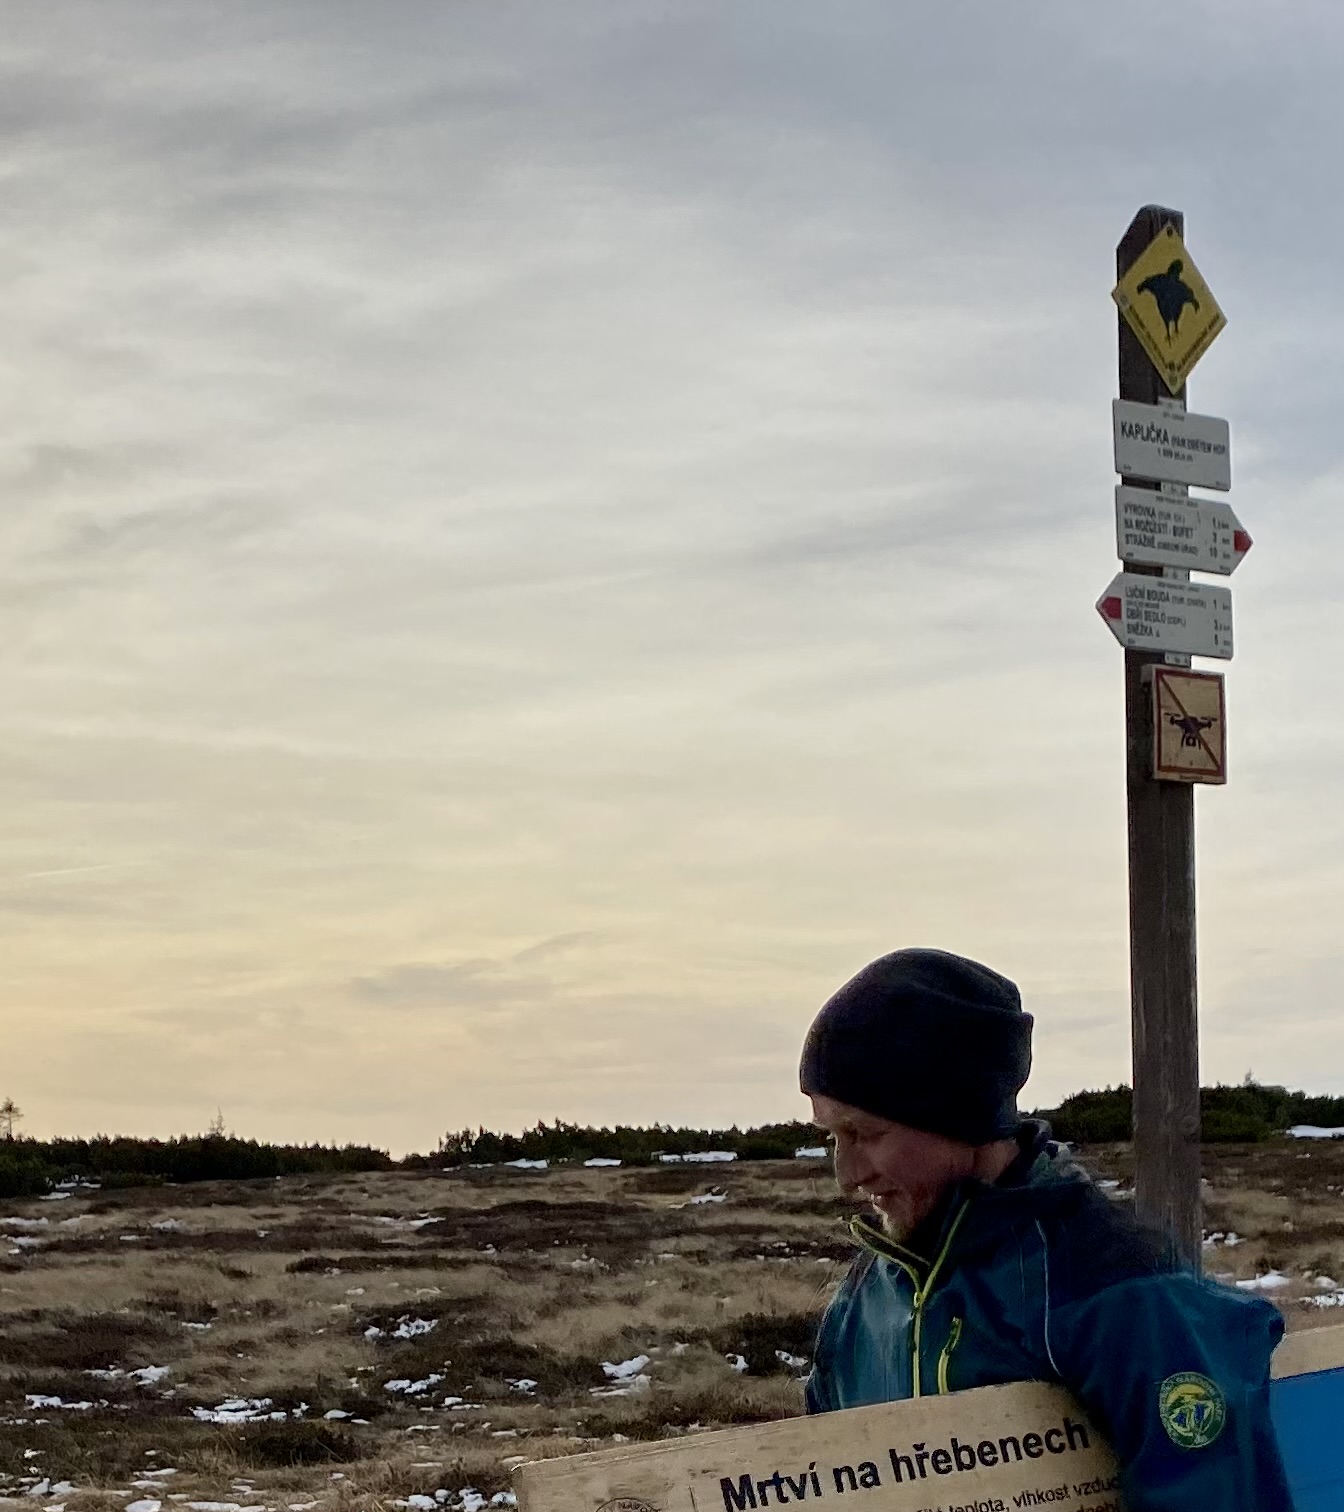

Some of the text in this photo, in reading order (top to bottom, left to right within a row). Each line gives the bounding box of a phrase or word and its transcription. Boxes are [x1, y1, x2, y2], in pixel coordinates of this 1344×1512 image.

[1121, 421, 1170, 446] KAPLIČKA
[719, 1417, 1088, 1512] Mrtví na hřebenech
[1012, 1483, 1070, 1508] vlhkost
